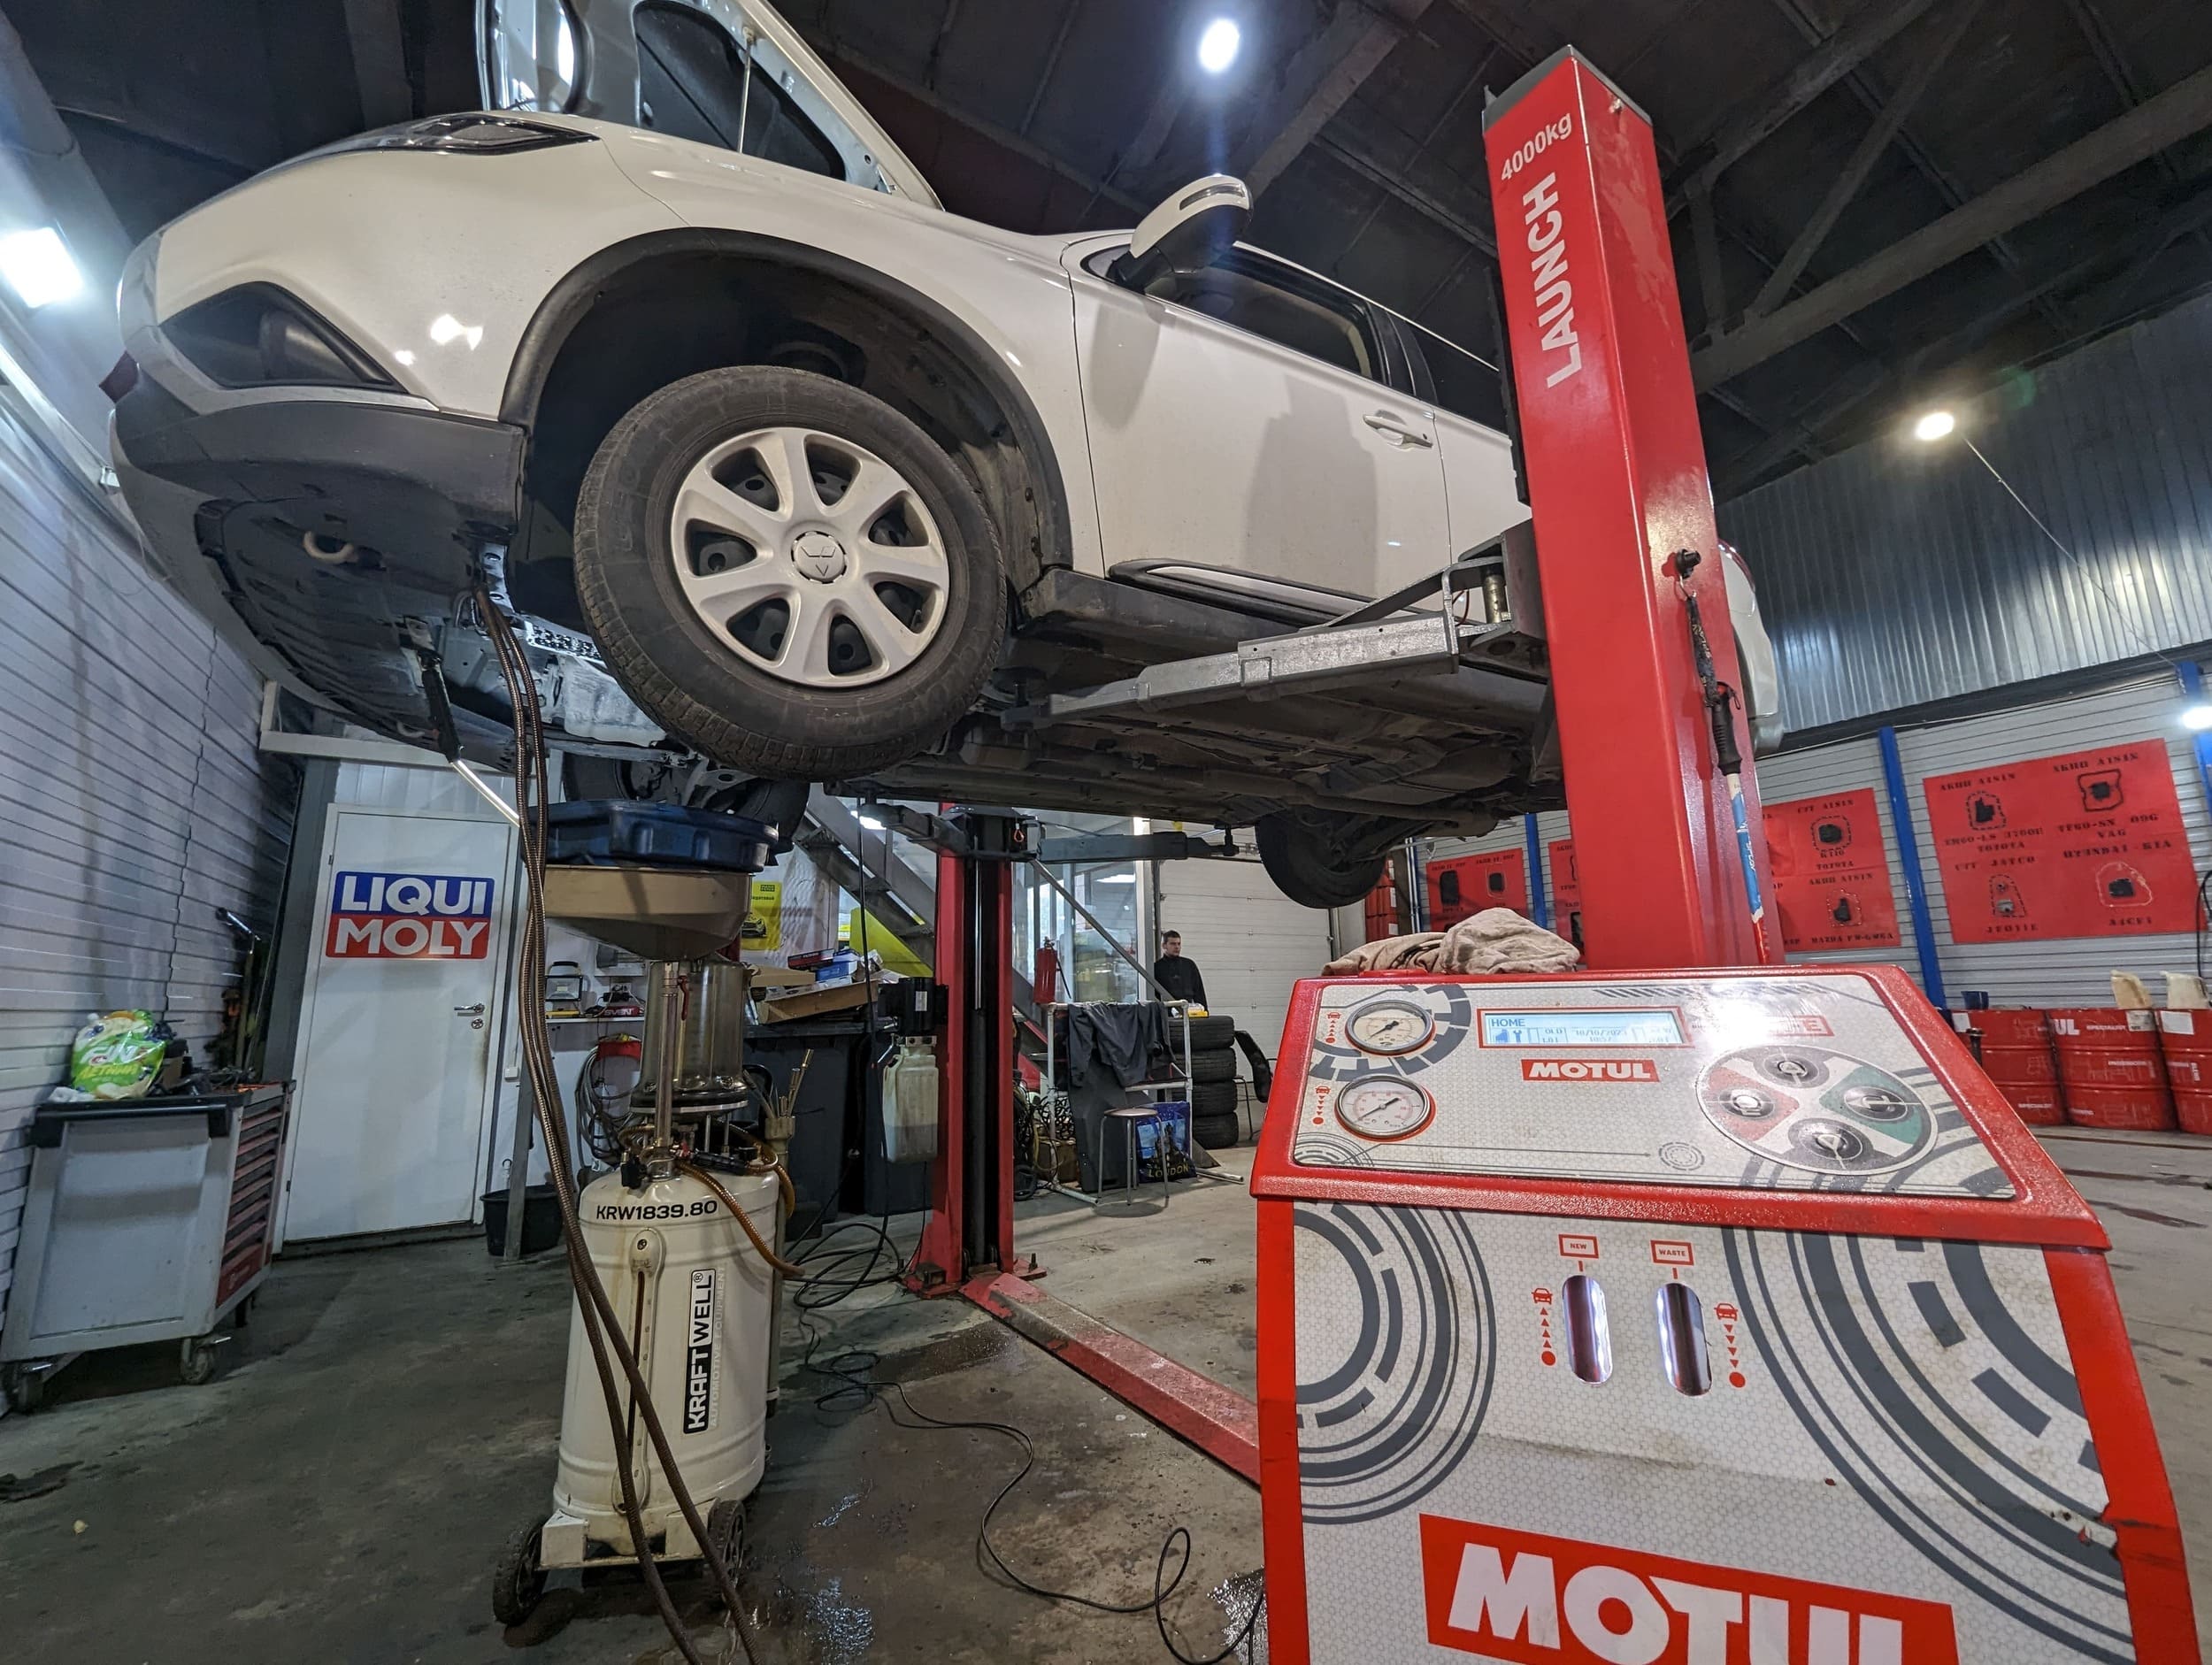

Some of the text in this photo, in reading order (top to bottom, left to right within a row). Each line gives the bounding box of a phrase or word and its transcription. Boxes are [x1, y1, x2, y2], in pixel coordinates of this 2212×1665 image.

[1502, 112, 1572, 181] 4000kg
[1522, 172, 1582, 389] LAUNCH
[341, 875, 488, 916] LIQUI
[334, 918, 488, 955] MOLY
[1491, 1018, 1525, 1027] HOME
[1528, 1062, 1651, 1078] MOTUL
[596, 1200, 718, 1220] KRW1839.80
[1658, 1248, 1686, 1257] WASTE
[710, 1265, 726, 1428] AUTOMOTIVE EQUIPMENT
